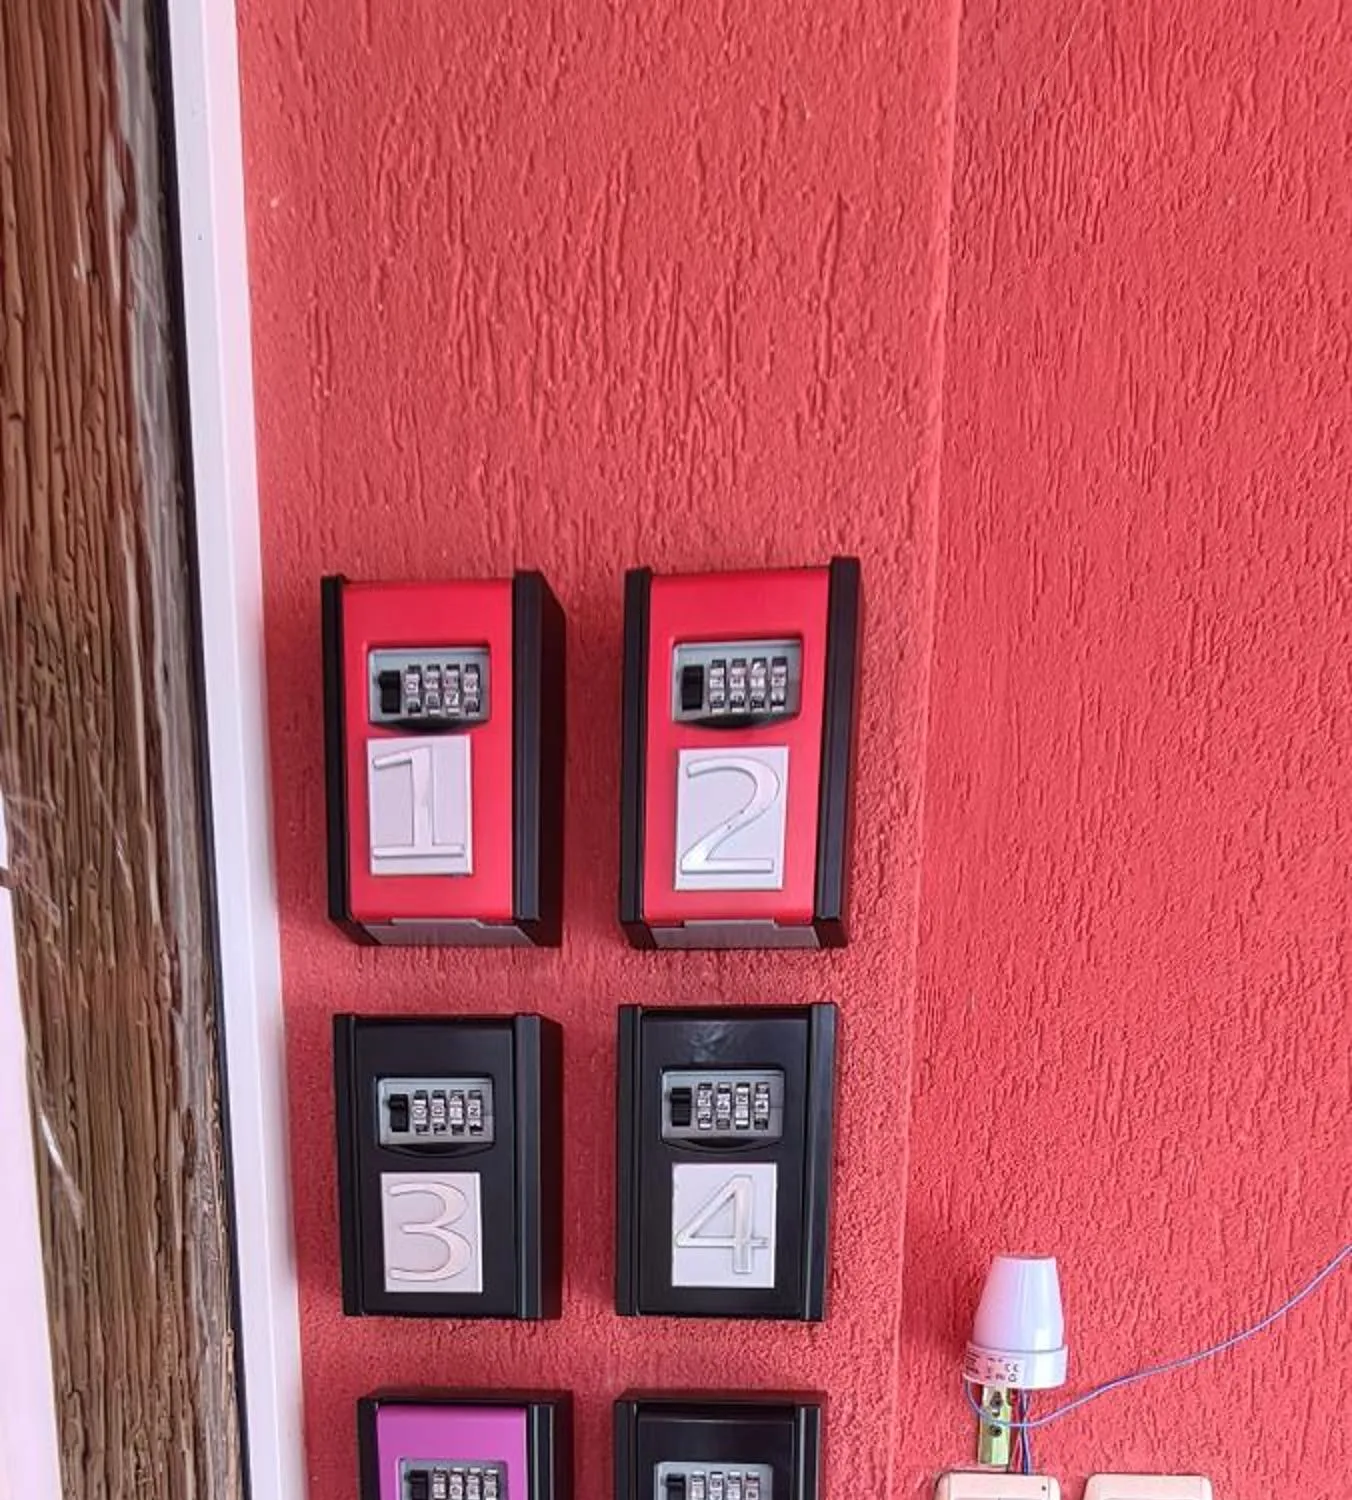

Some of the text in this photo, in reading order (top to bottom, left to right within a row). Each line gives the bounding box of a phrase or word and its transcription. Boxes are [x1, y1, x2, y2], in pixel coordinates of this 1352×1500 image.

[372, 744, 466, 861] 1
[680, 755, 781, 876] 2
[388, 1181, 474, 1282] 3
[676, 1174, 769, 1275] 4
